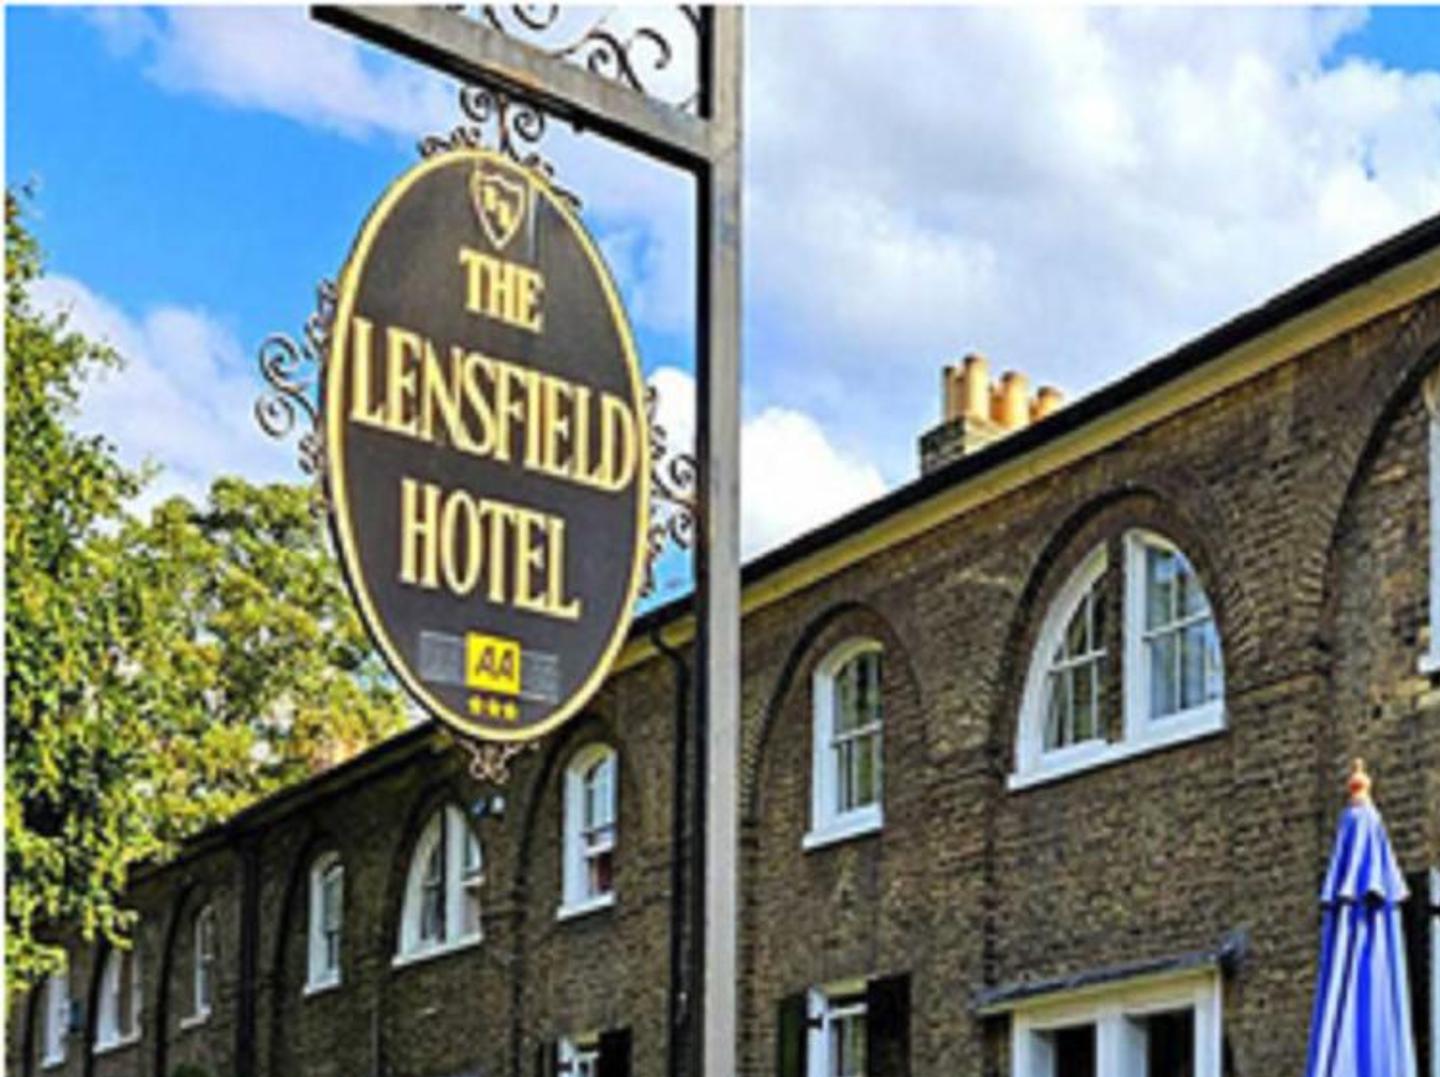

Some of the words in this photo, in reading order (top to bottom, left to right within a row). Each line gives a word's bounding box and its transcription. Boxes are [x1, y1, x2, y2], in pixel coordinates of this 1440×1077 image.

[459, 247, 545, 335] THE
[350, 316, 637, 492] LENSFIELD
[400, 478, 580, 620] HOTEL
[475, 645, 514, 683] AA
